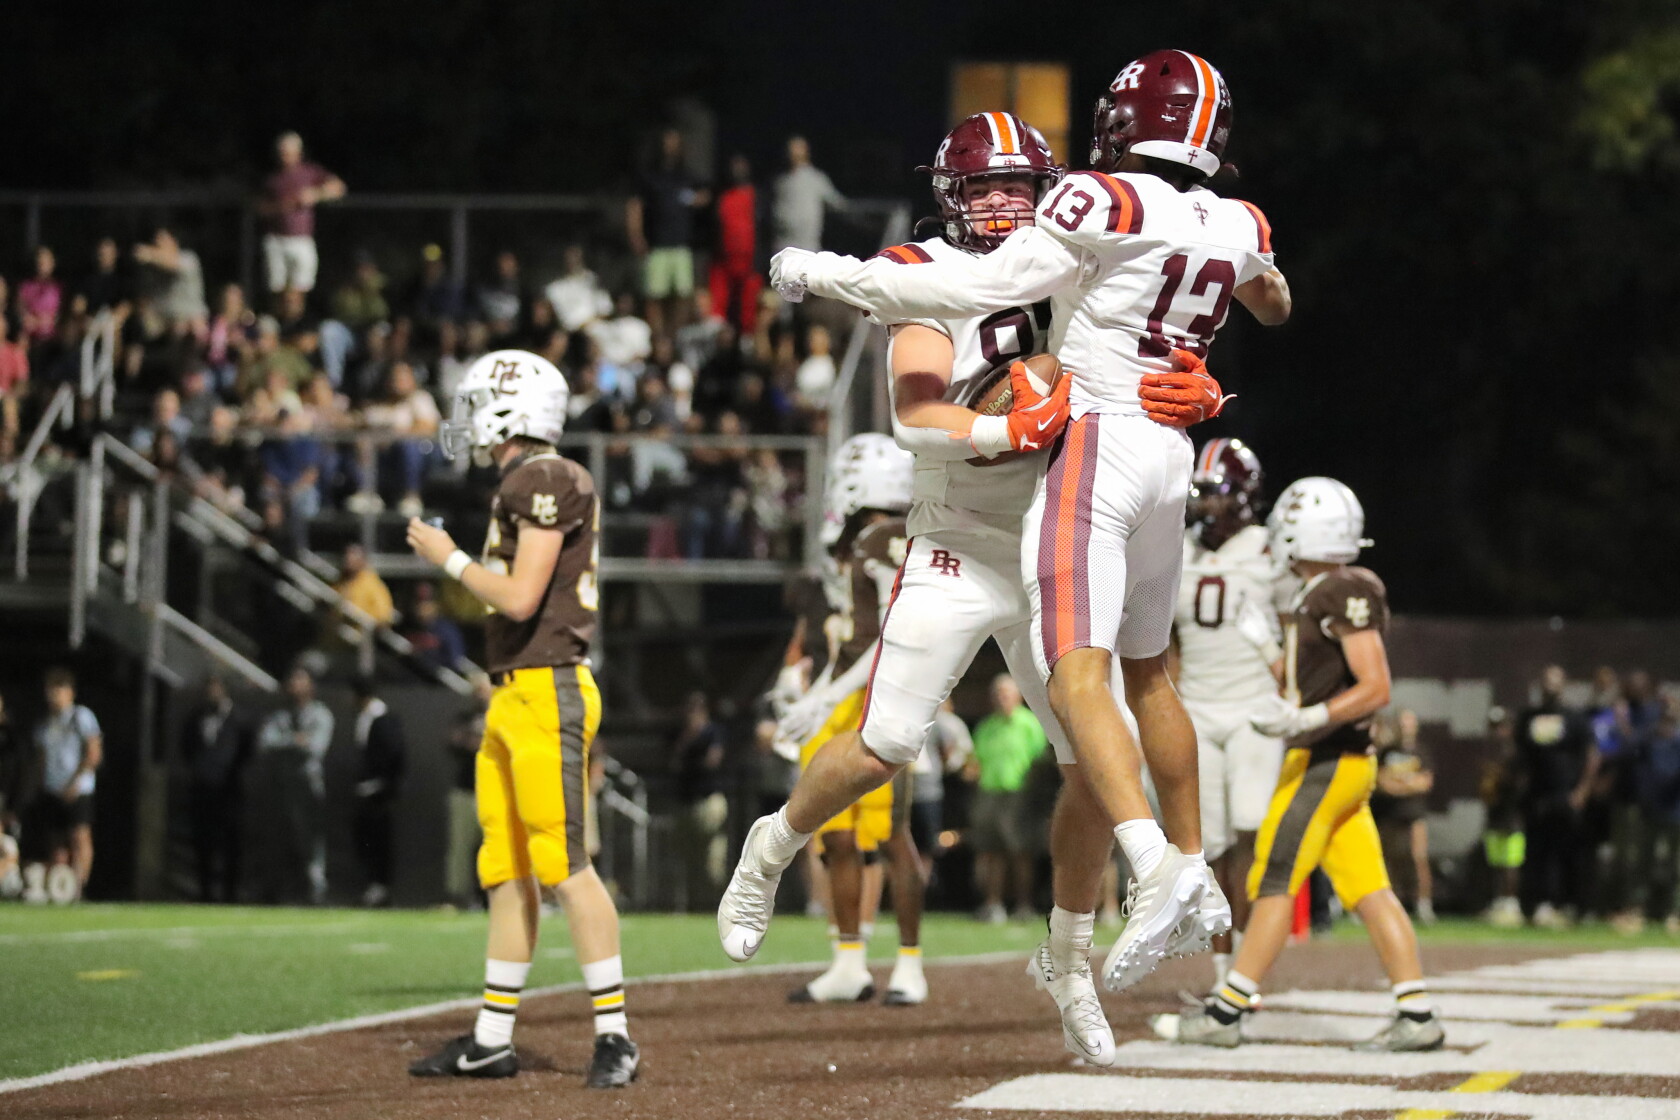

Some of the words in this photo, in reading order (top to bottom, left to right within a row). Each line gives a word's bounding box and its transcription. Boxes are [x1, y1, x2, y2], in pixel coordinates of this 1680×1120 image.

[1042, 183, 1095, 232] 13
[1138, 253, 1236, 360] 13
[982, 389, 1012, 416] ilson
[930, 549, 961, 577] BR
[1195, 575, 1225, 628] 0
